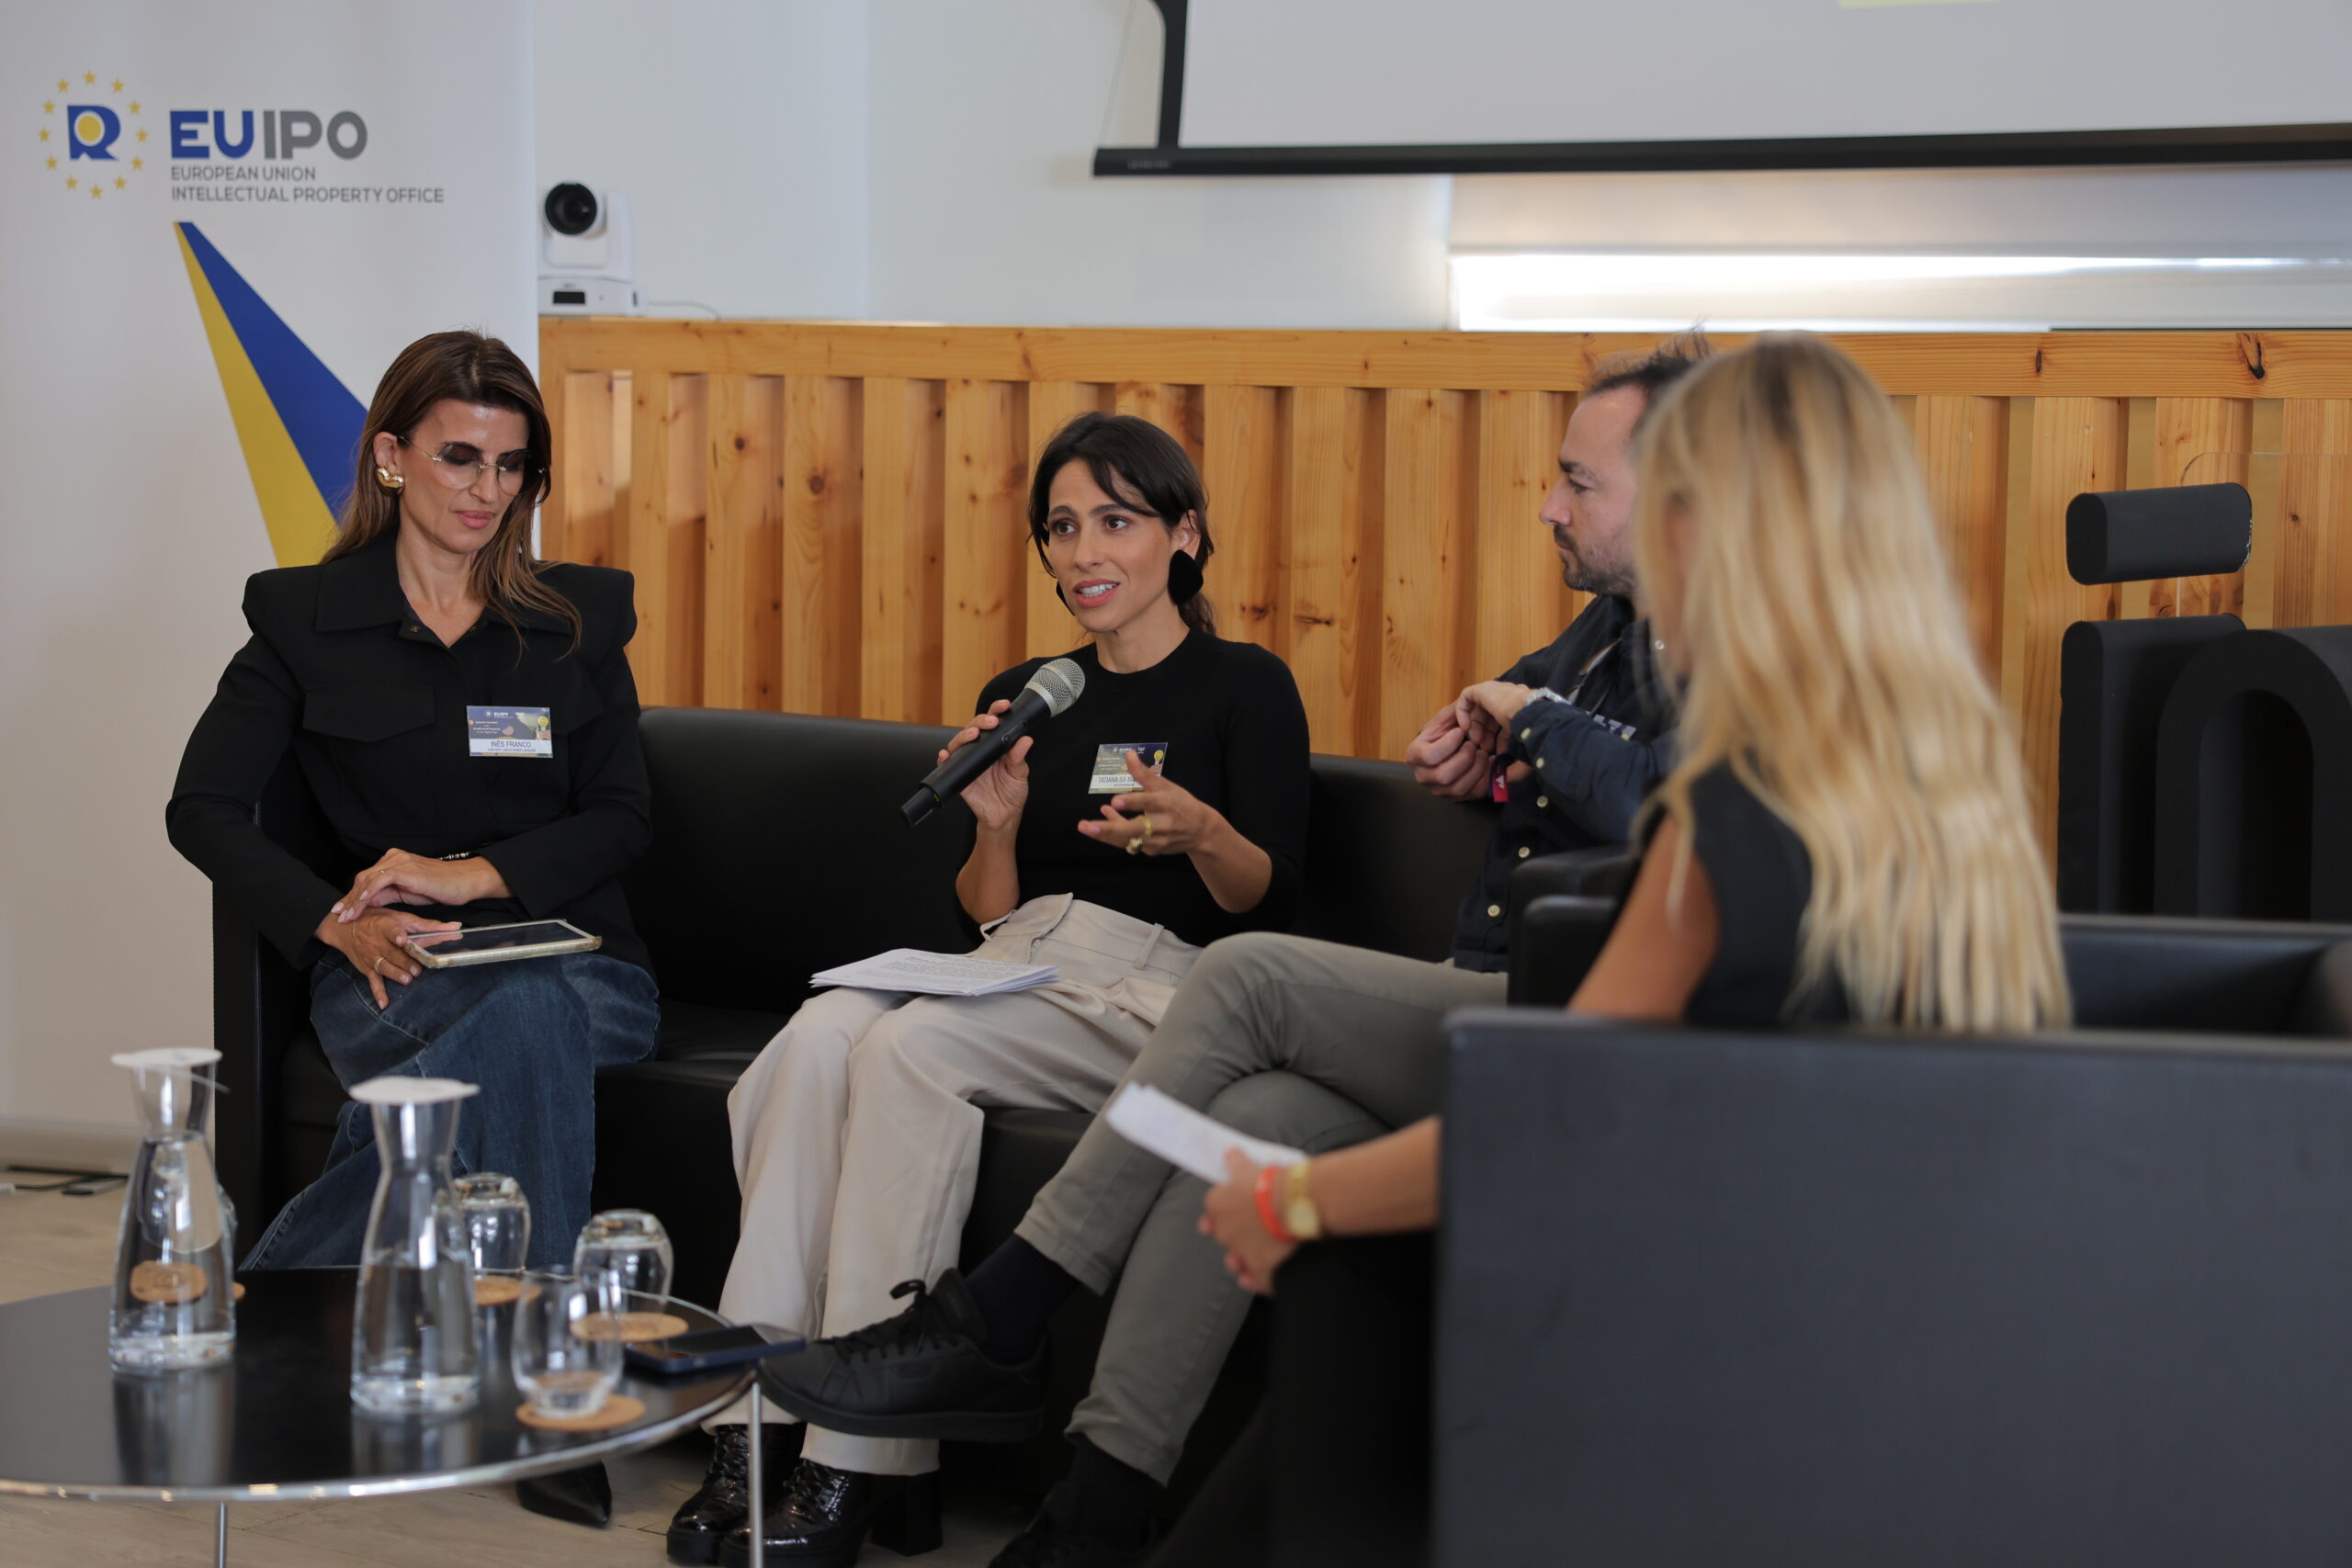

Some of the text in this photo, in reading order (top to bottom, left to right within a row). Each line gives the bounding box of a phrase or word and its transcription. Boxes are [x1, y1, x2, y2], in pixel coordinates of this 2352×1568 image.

[169, 109, 368, 160] EUIPO
[171, 164, 316, 182] EUROPEAN UNION
[171, 186, 445, 204] INTELLECTUAL PROPERTY OFFICE
